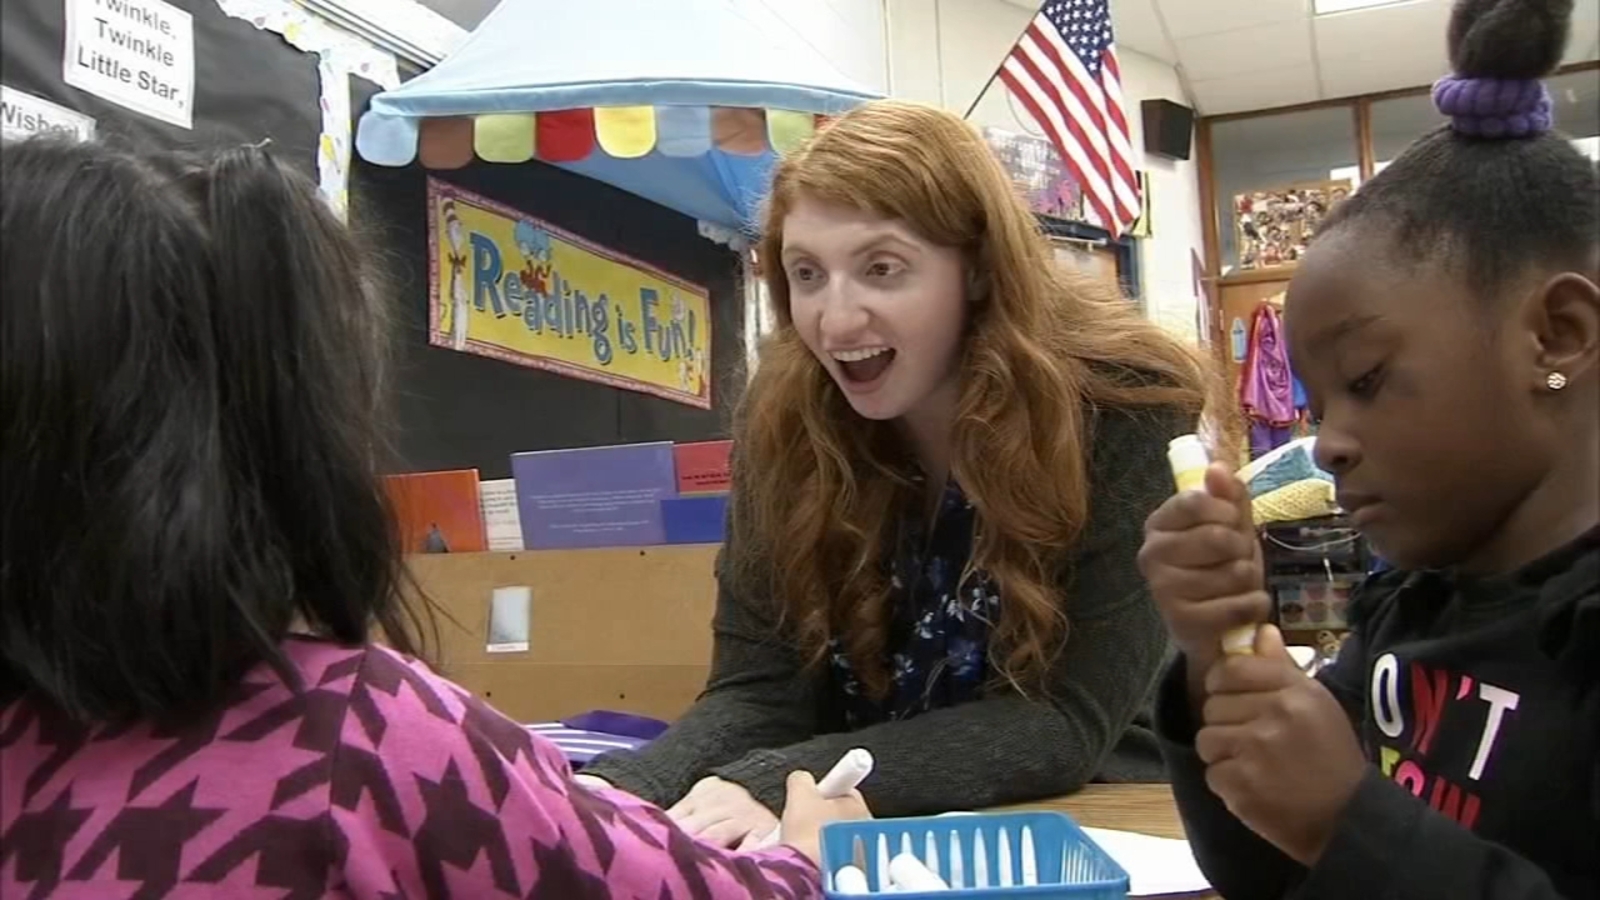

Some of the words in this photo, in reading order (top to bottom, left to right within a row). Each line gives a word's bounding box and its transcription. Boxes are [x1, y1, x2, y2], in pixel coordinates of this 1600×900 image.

[94, 17, 174, 67] Twinkle
[95, 0, 177, 40] winkle,
[77, 45, 132, 83] Little
[137, 70, 184, 109] Star,
[470, 231, 612, 365] Reading
[615, 303, 637, 354] is
[640, 287, 695, 362] Fun!
